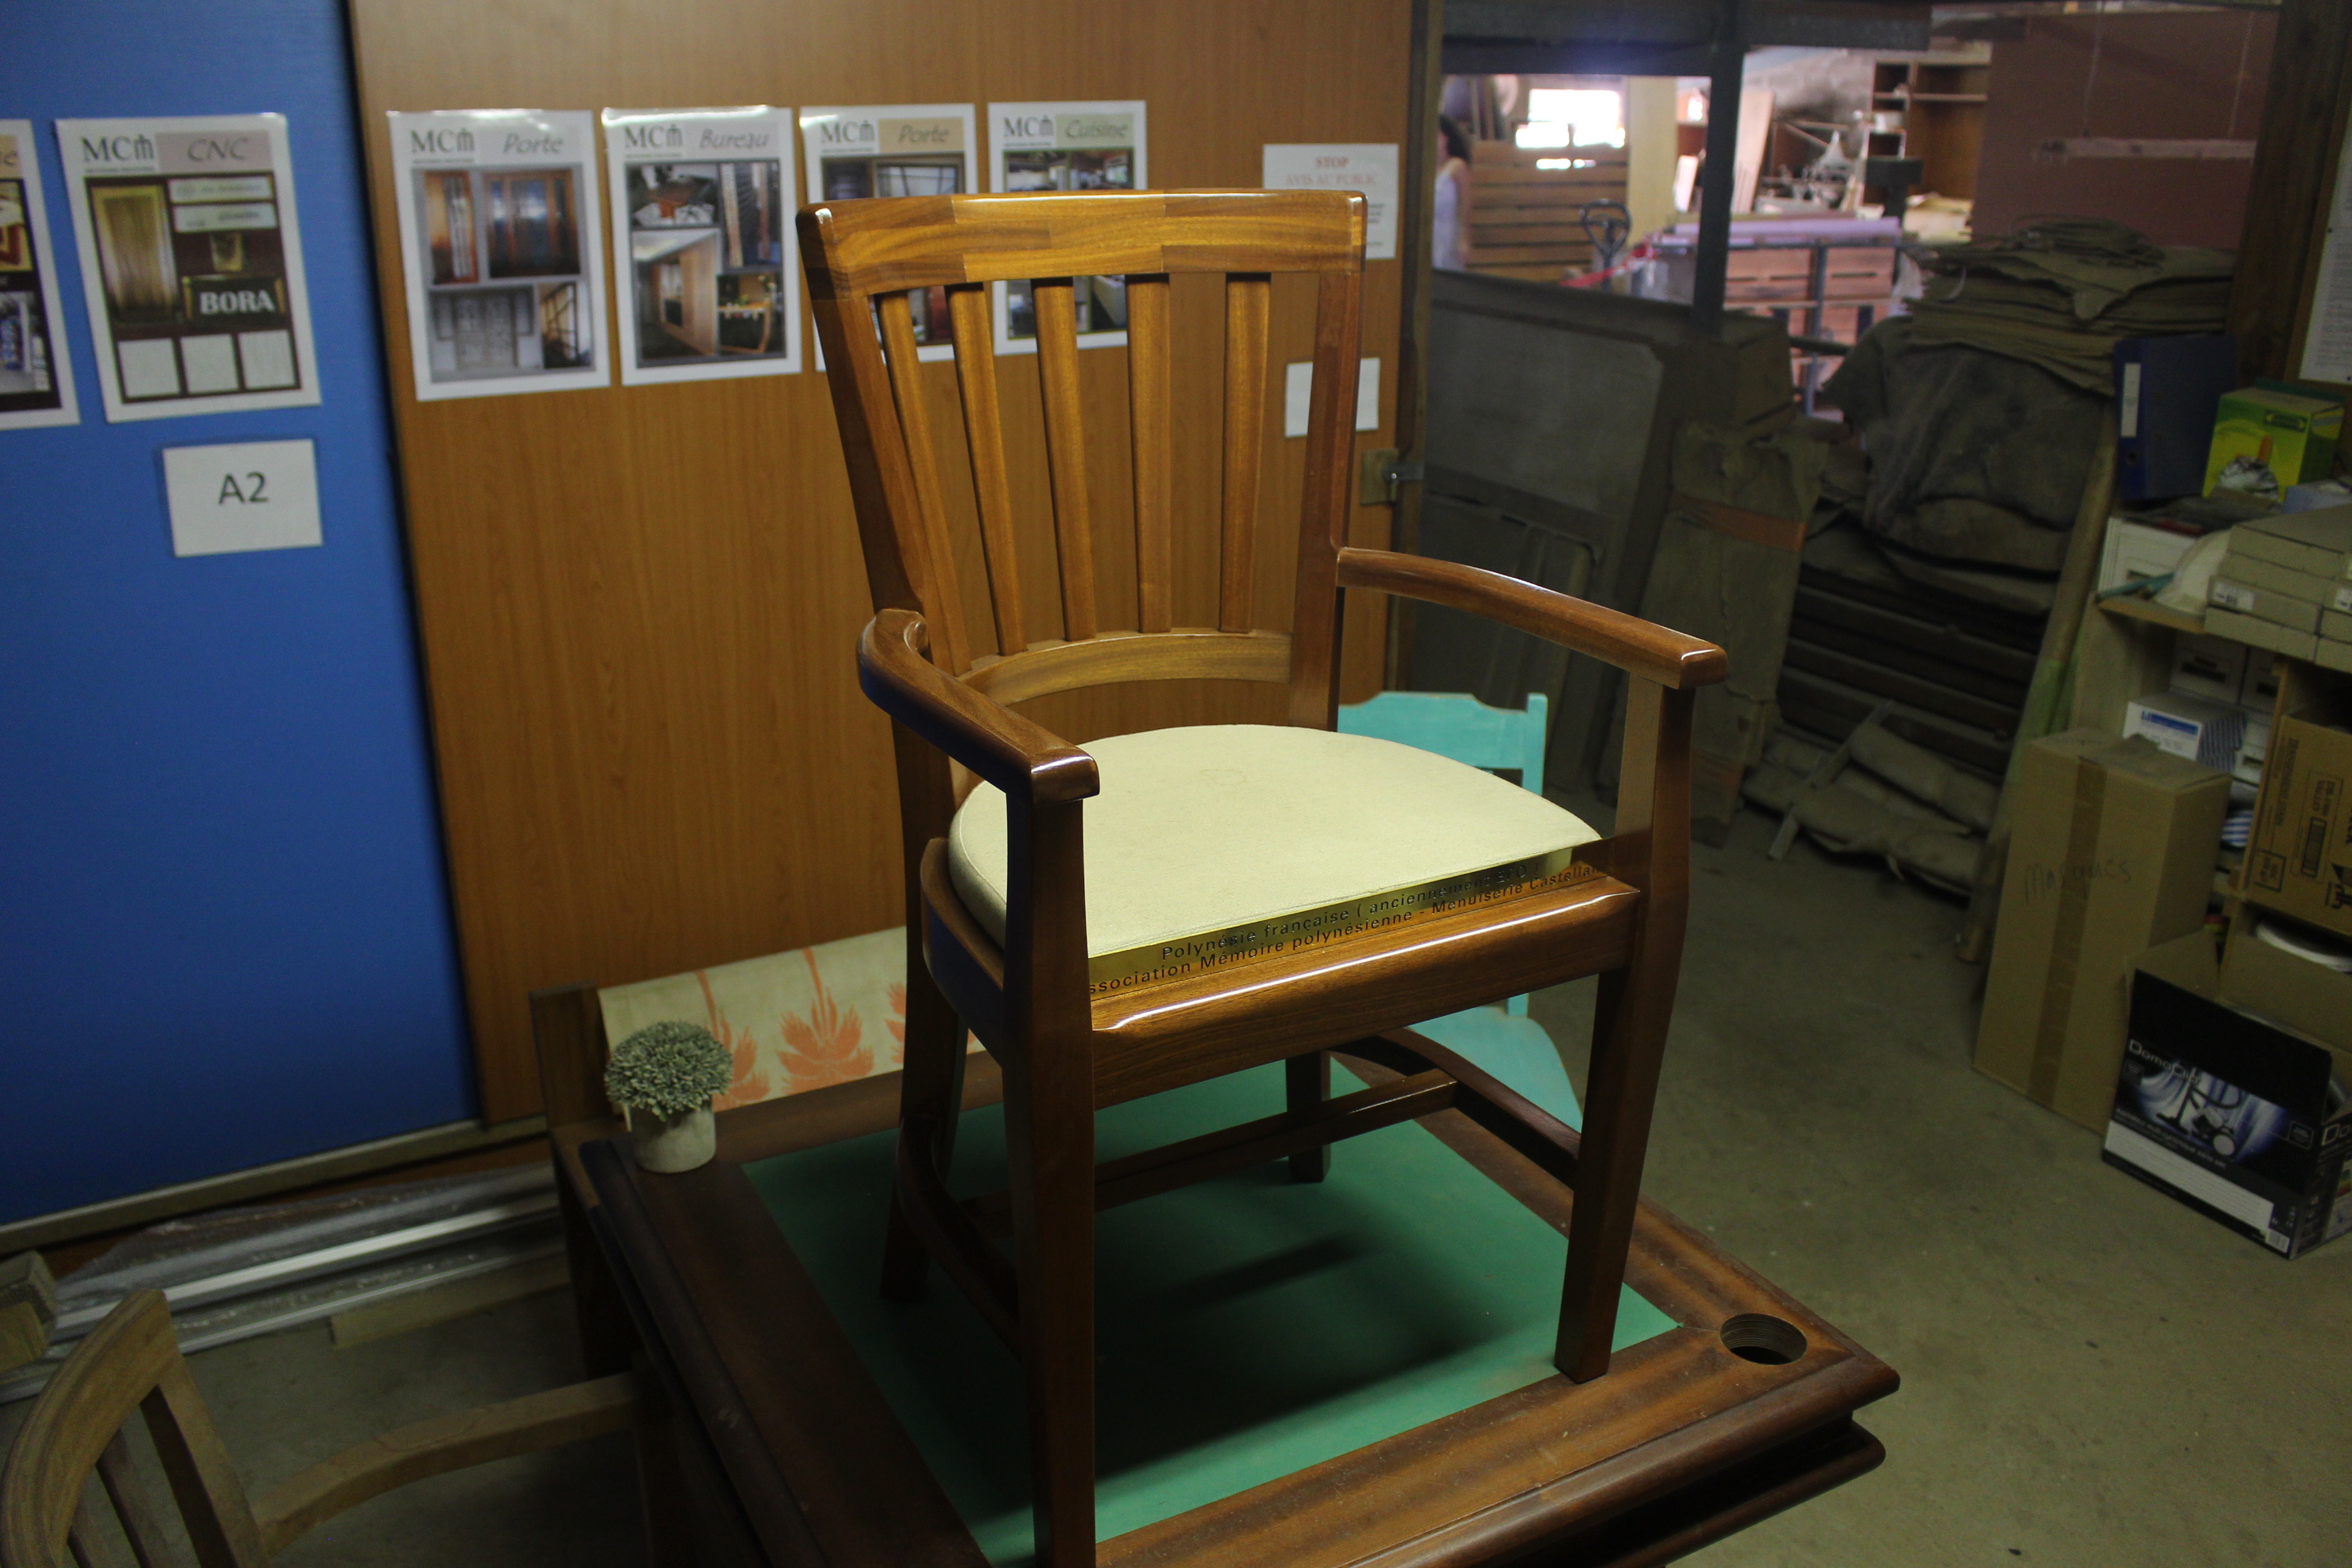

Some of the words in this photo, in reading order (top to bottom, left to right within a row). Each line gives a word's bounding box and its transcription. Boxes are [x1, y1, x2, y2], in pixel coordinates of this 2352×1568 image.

[503, 132, 564, 154] Porte
[699, 128, 770, 149] Bureau
[898, 124, 950, 144] Porte
[186, 137, 249, 162] CNC
[199, 289, 276, 316] BORA
[218, 471, 270, 505] A2
[1162, 930, 1256, 961] Polynésie
[1264, 910, 1350, 938] française
[1369, 875, 1490, 914] anciennement
[1497, 865, 1527, 883] EFO
[1089, 962, 1191, 994] ssociation
[1200, 941, 1284, 970] Mémoire
[1292, 911, 1413, 951] polynésienne
[1431, 884, 1523, 915] Menuiserie
[1530, 864, 1601, 890] Castellan
